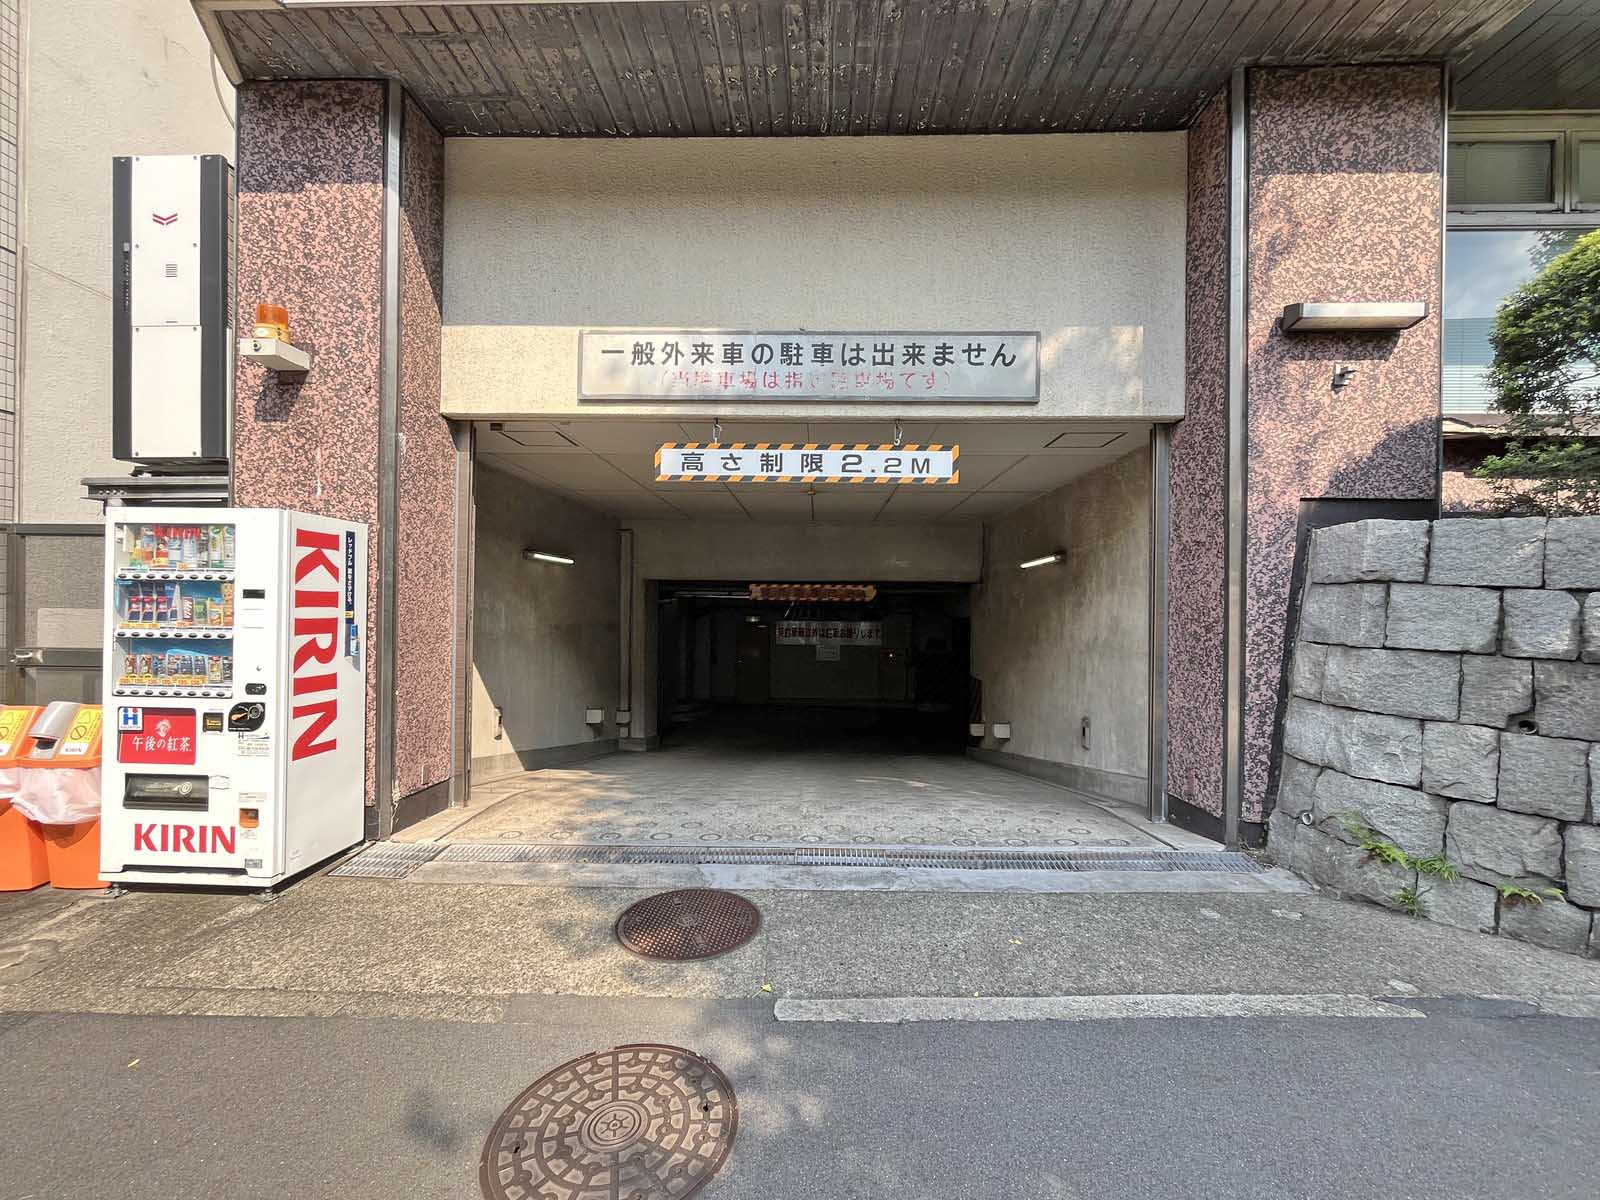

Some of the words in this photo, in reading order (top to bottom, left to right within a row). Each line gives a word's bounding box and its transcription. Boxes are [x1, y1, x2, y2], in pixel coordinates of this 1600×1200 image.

[602, 342, 1017, 367] 一般外来車の駐車は出来ません
[291, 528, 340, 761] KIRIN
[132, 735, 191, 752] 午後の紅茶
[134, 823, 236, 854] KIRIN
